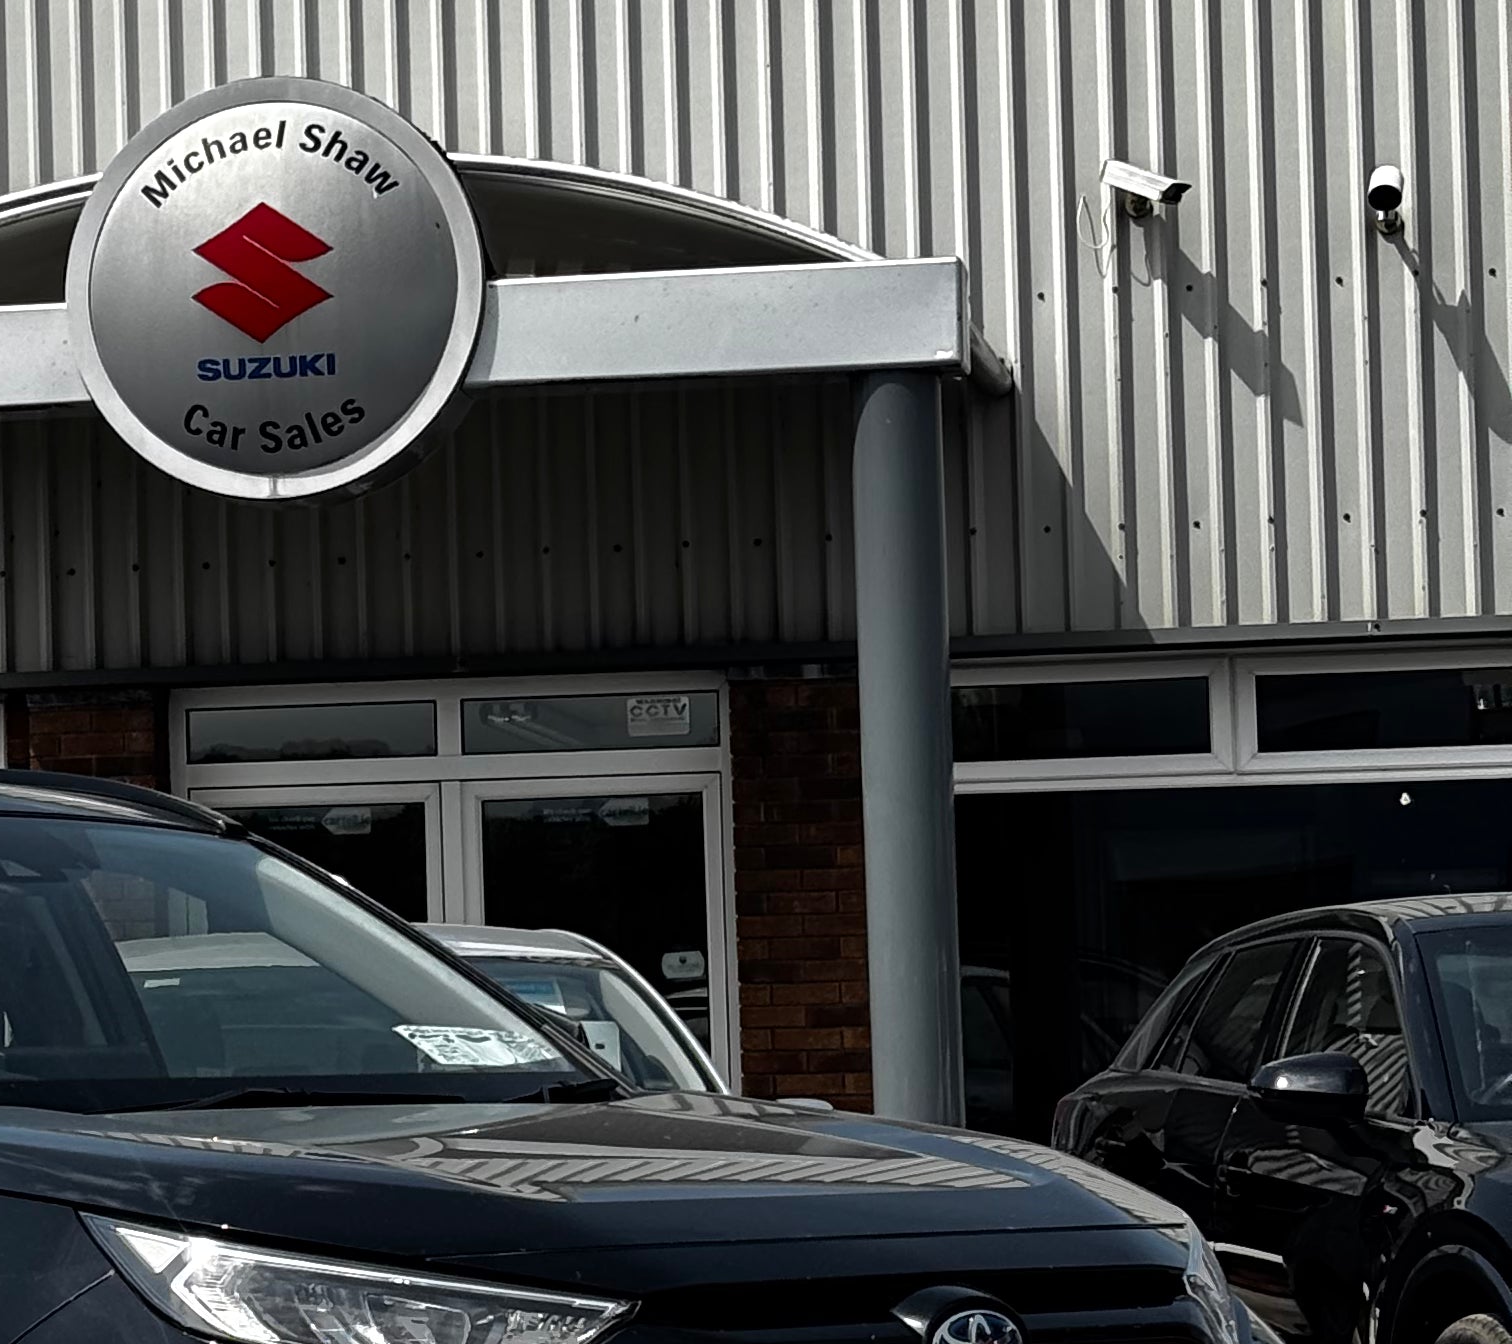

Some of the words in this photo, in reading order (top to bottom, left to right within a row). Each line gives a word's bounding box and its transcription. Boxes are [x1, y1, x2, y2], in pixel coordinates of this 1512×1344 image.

[140, 120, 286, 209] Michael
[298, 123, 400, 197] Shaw
[196, 352, 336, 382] SUZUKI
[183, 403, 246, 451] Car
[258, 397, 366, 454] Sales
[630, 703, 687, 717] CCTV
